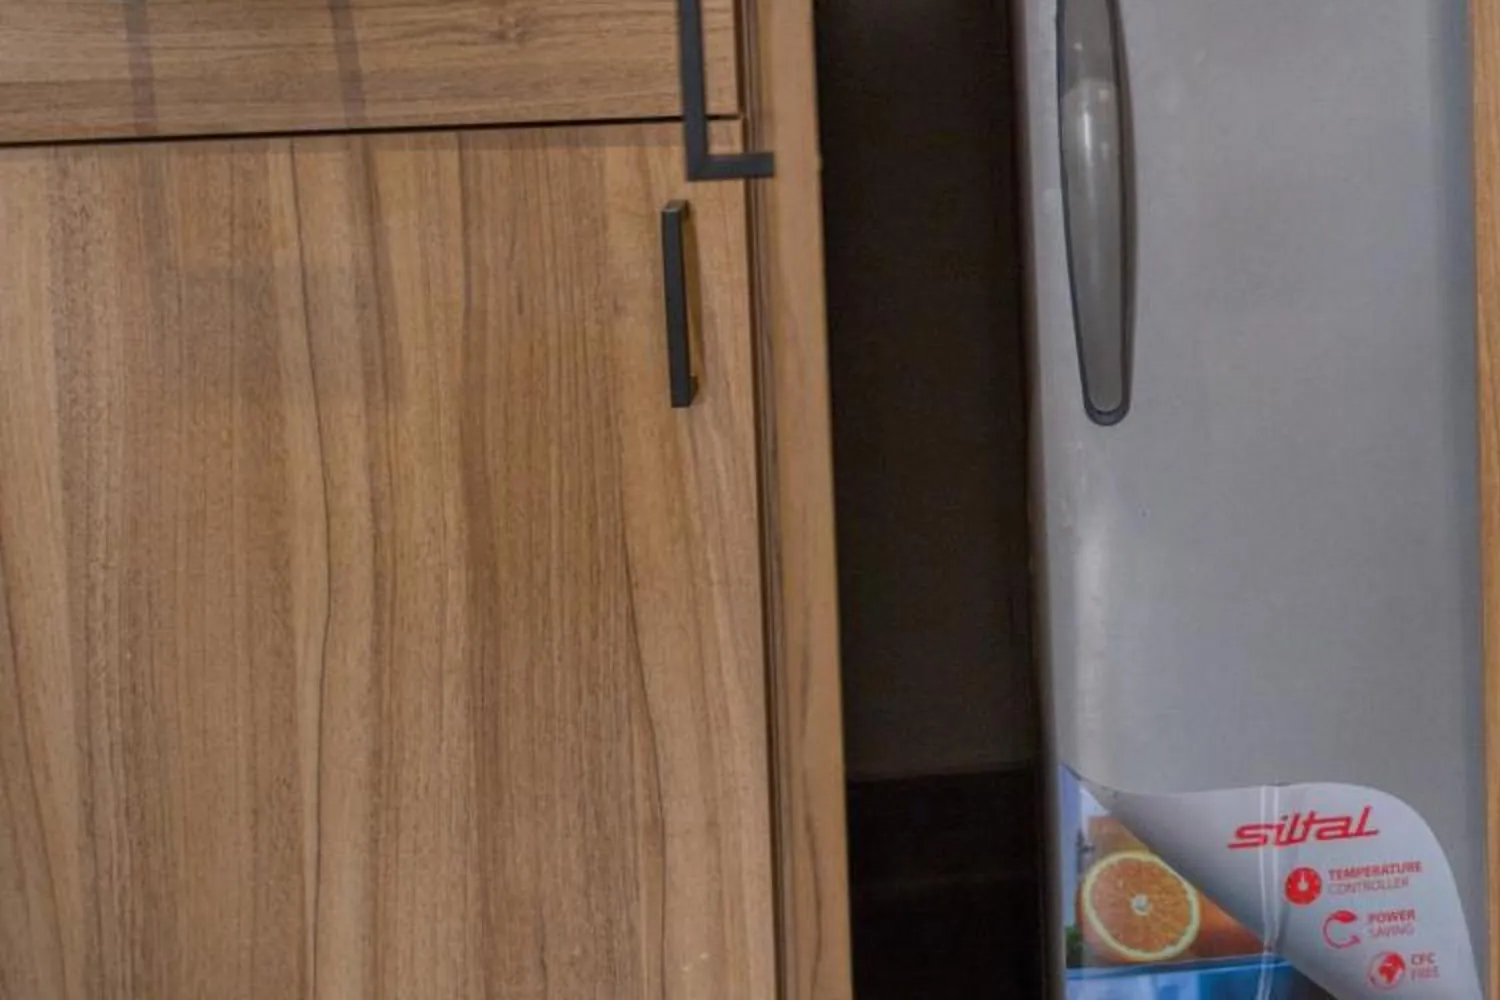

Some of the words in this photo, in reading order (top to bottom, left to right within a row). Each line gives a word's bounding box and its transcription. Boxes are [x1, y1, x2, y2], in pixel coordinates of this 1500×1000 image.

[1328, 861, 1422, 881] TEMPERATURE
[1328, 877, 1409, 894] CONTROLLER
[1367, 909, 1416, 923] POWER
[1368, 923, 1415, 938] SAVING
[1410, 952, 1436, 966] CFC
[1411, 966, 1440, 980] FREE
